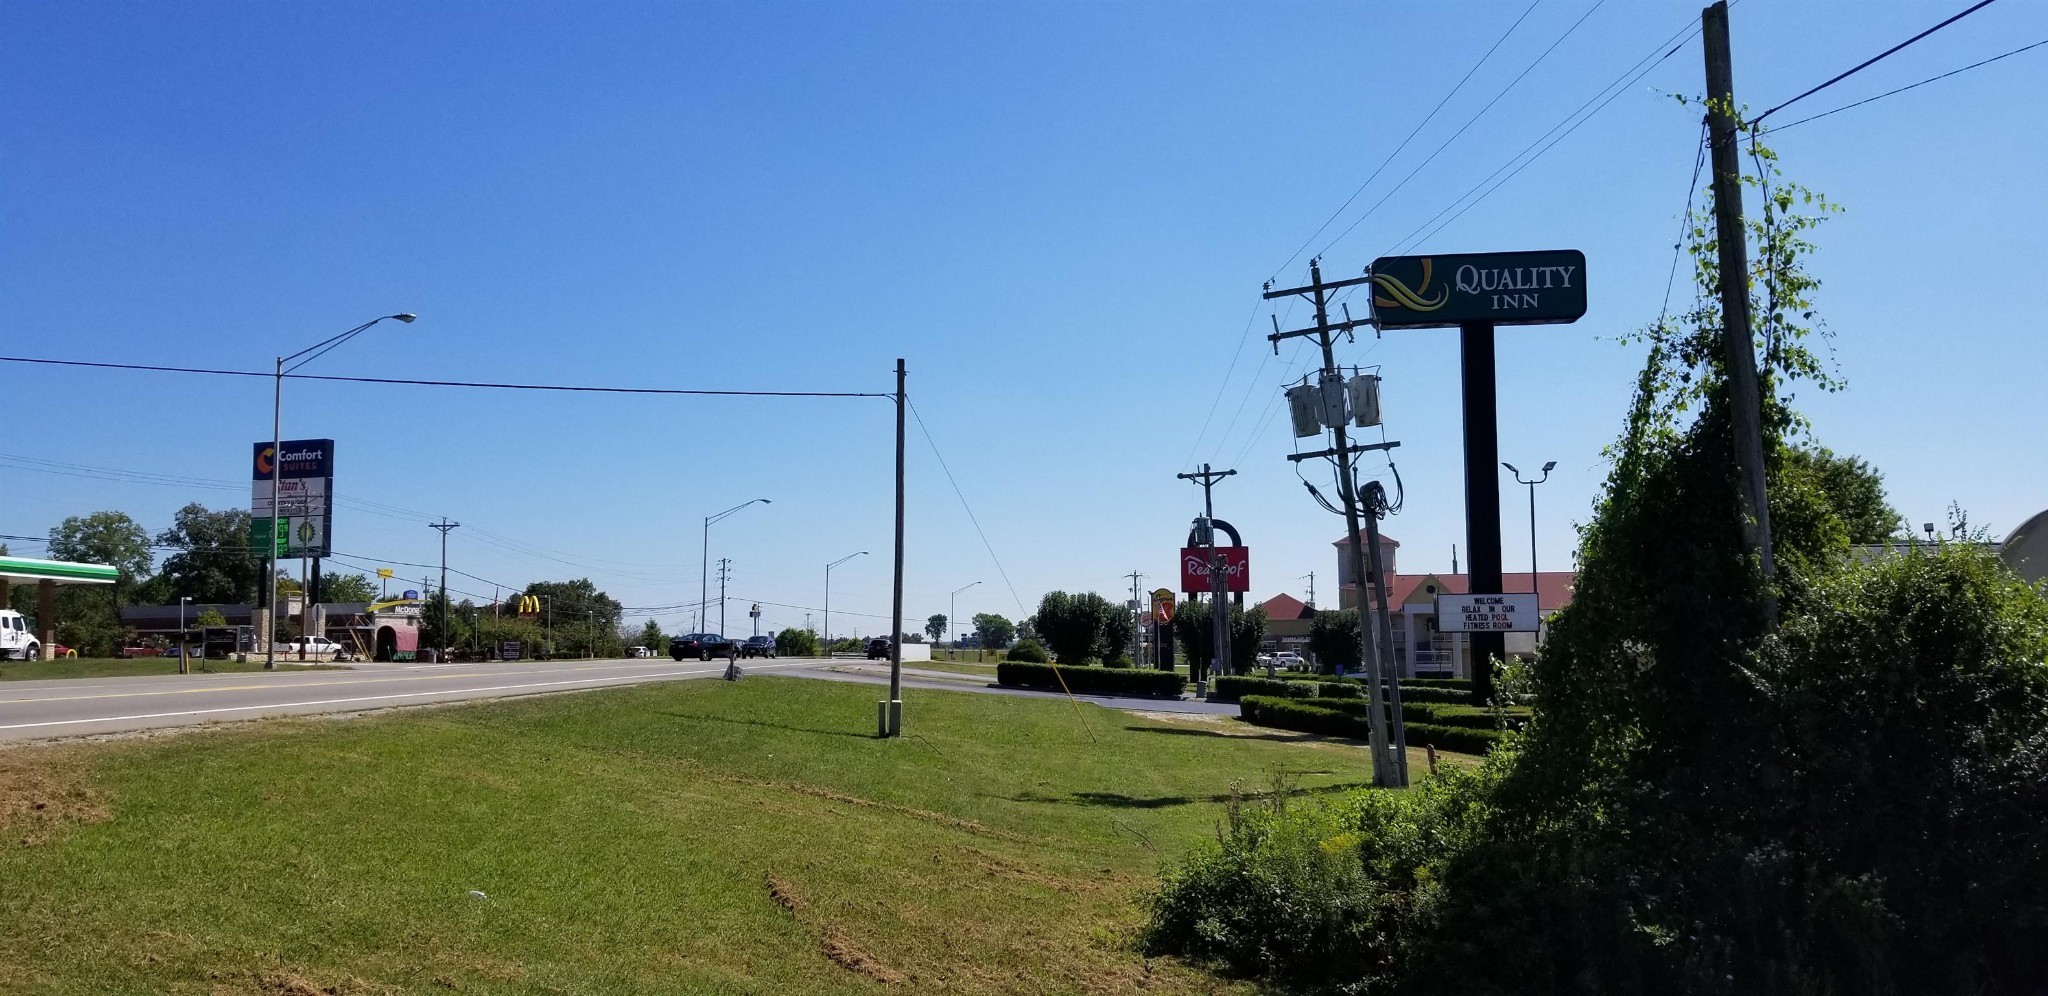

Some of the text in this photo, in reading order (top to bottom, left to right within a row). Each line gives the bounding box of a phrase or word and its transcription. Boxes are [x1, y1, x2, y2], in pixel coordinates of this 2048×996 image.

[1455, 264, 1575, 295] QUALITY
[1491, 293, 1539, 310] INN
[279, 448, 322, 462] Comfort
[283, 462, 317, 472] SUITES
[1473, 597, 1504, 605] WELCOME
[1461, 605, 1515, 613] RELAX IN OUR
[1465, 613, 1509, 621] HEATED POOL
[1463, 621, 1513, 630] FITNESS ROOM
